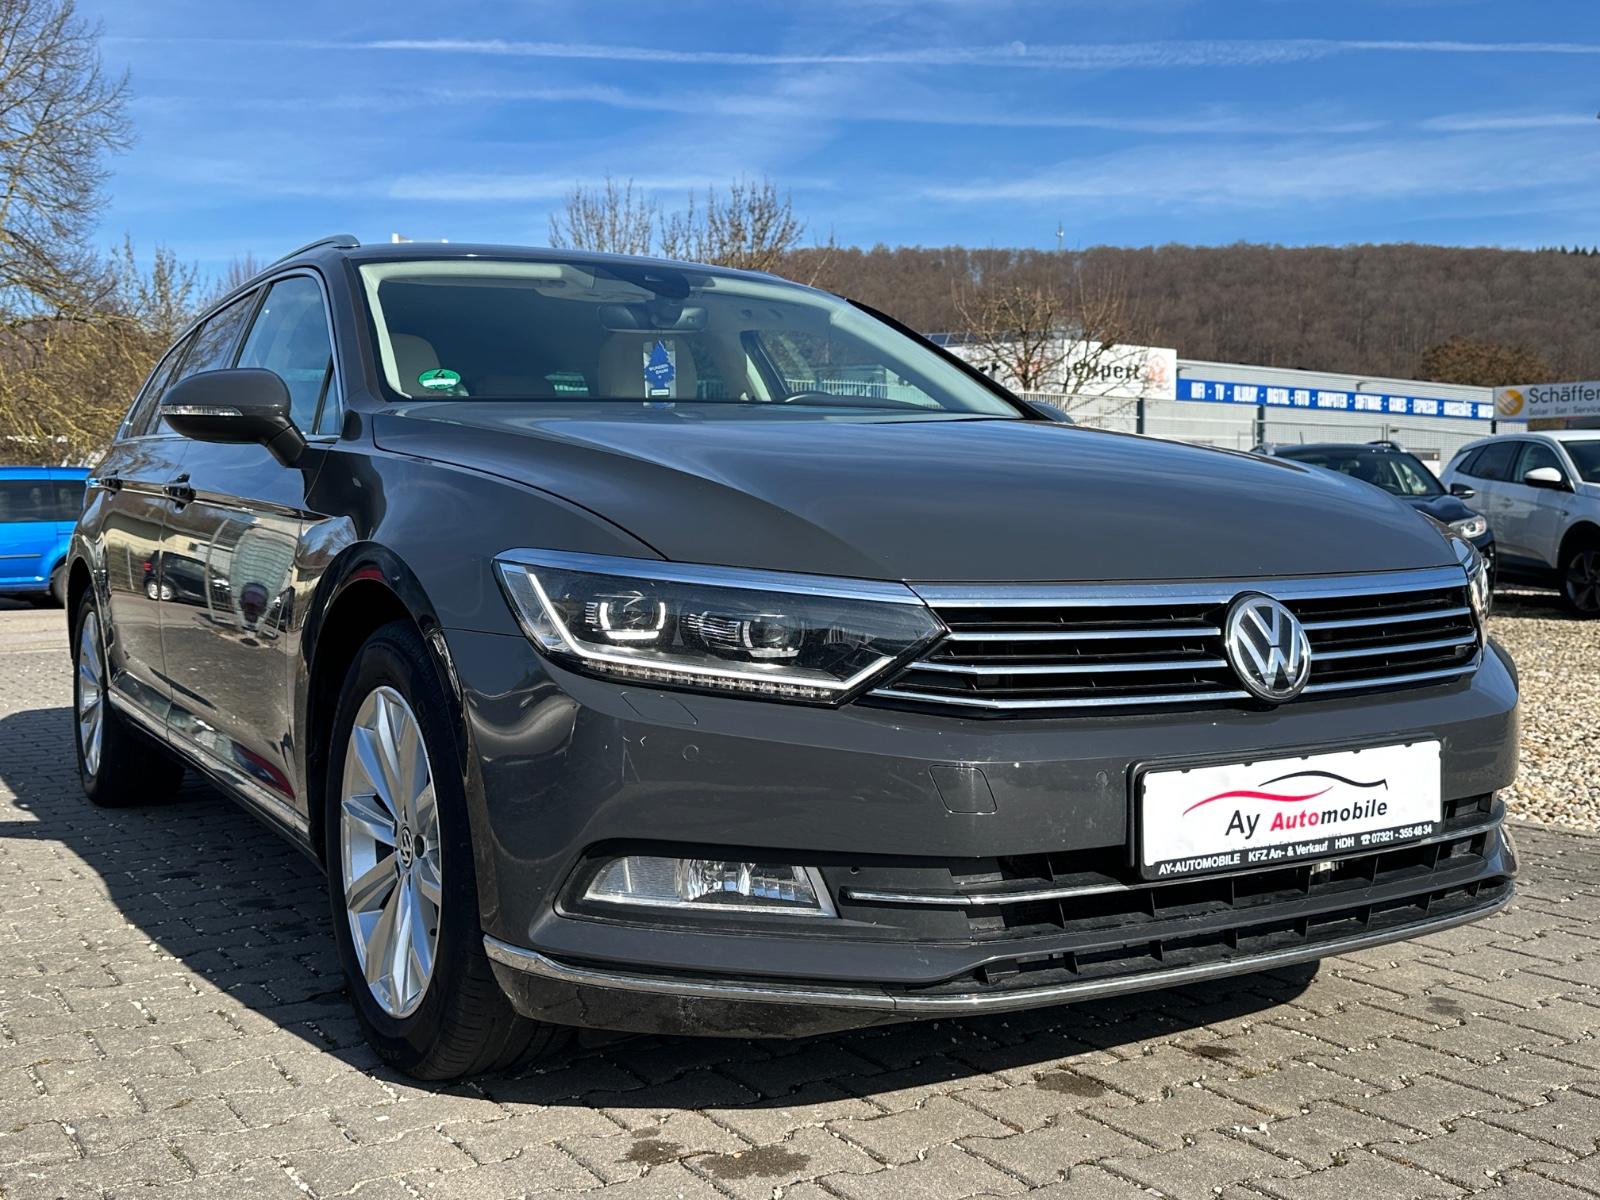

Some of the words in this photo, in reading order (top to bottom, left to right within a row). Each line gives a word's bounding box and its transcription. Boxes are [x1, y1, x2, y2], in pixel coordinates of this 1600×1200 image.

[1225, 809, 1260, 840] Ay
[1269, 799, 1388, 832] Automobile
[1158, 853, 1241, 875] AY-AUTOMOBILE
[1248, 849, 1268, 862] KFZ
[1286, 847, 1295, 857] &
[1295, 841, 1329, 856] Verkauf
[1335, 837, 1355, 849] HDH
[1372, 830, 1394, 844] 07321
